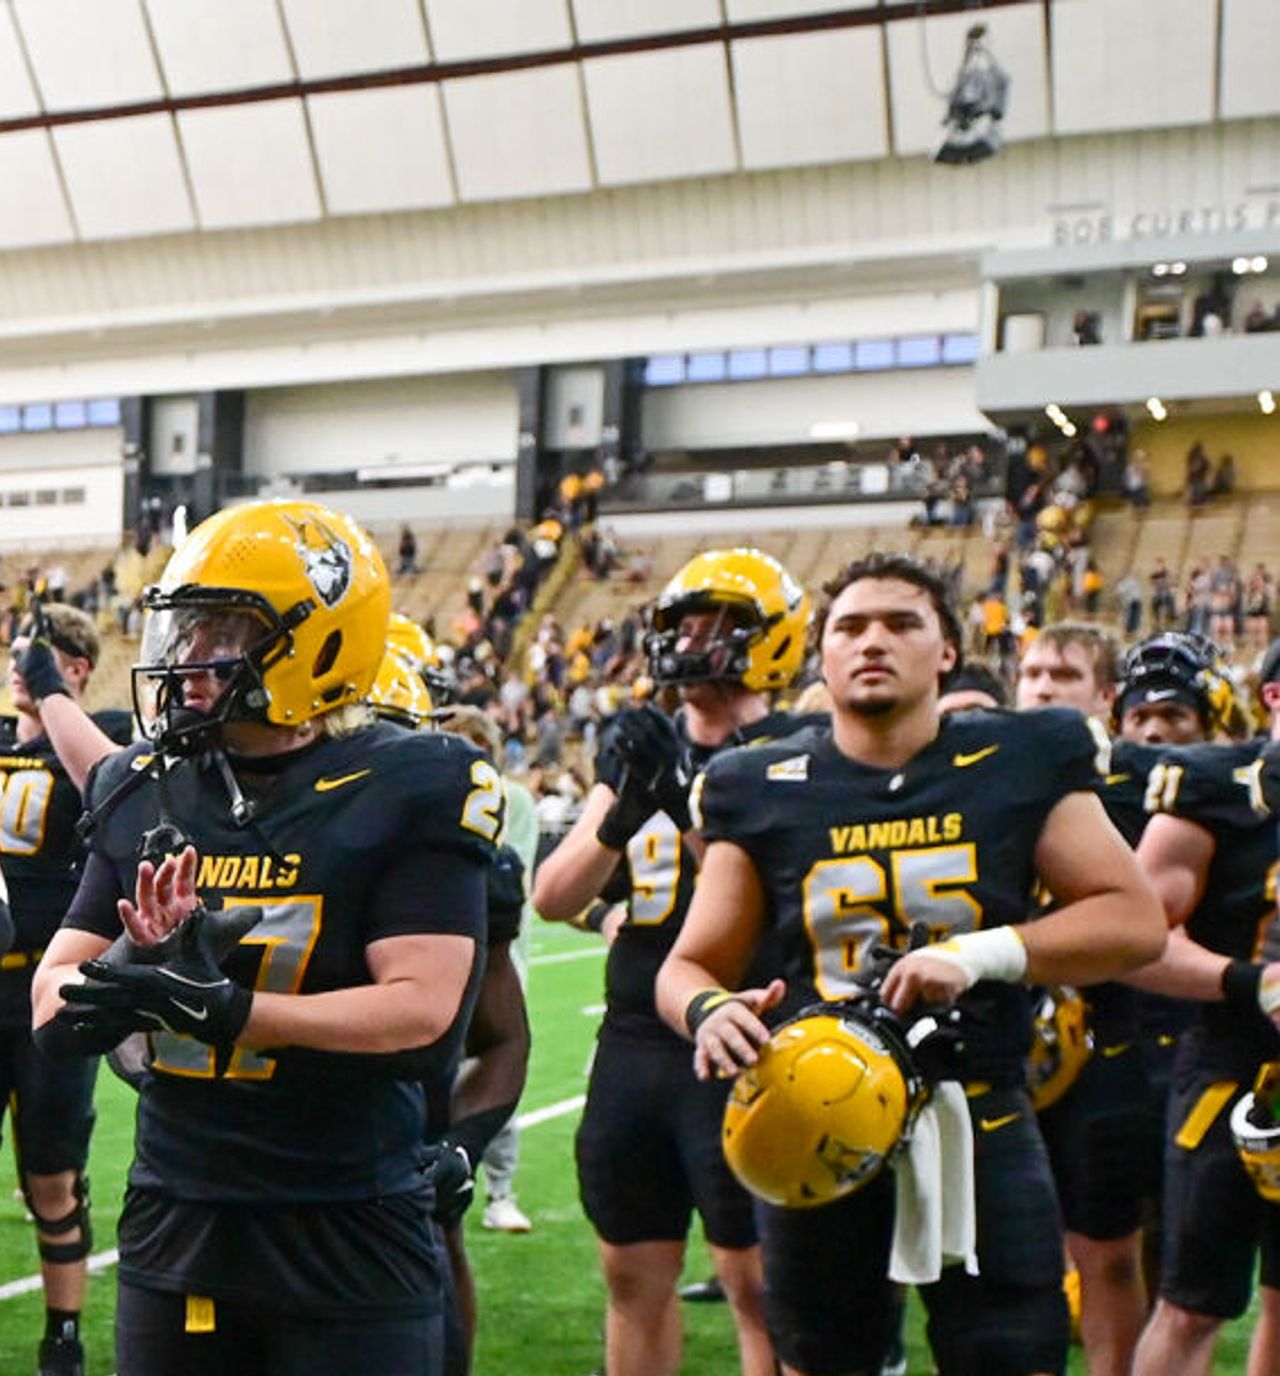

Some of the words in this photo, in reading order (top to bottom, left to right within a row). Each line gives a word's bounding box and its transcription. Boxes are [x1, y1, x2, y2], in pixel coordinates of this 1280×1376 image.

[1132, 202, 1247, 240] CURTIS
[830, 813, 962, 853] VANDALS
[802, 842, 983, 1002] 65
